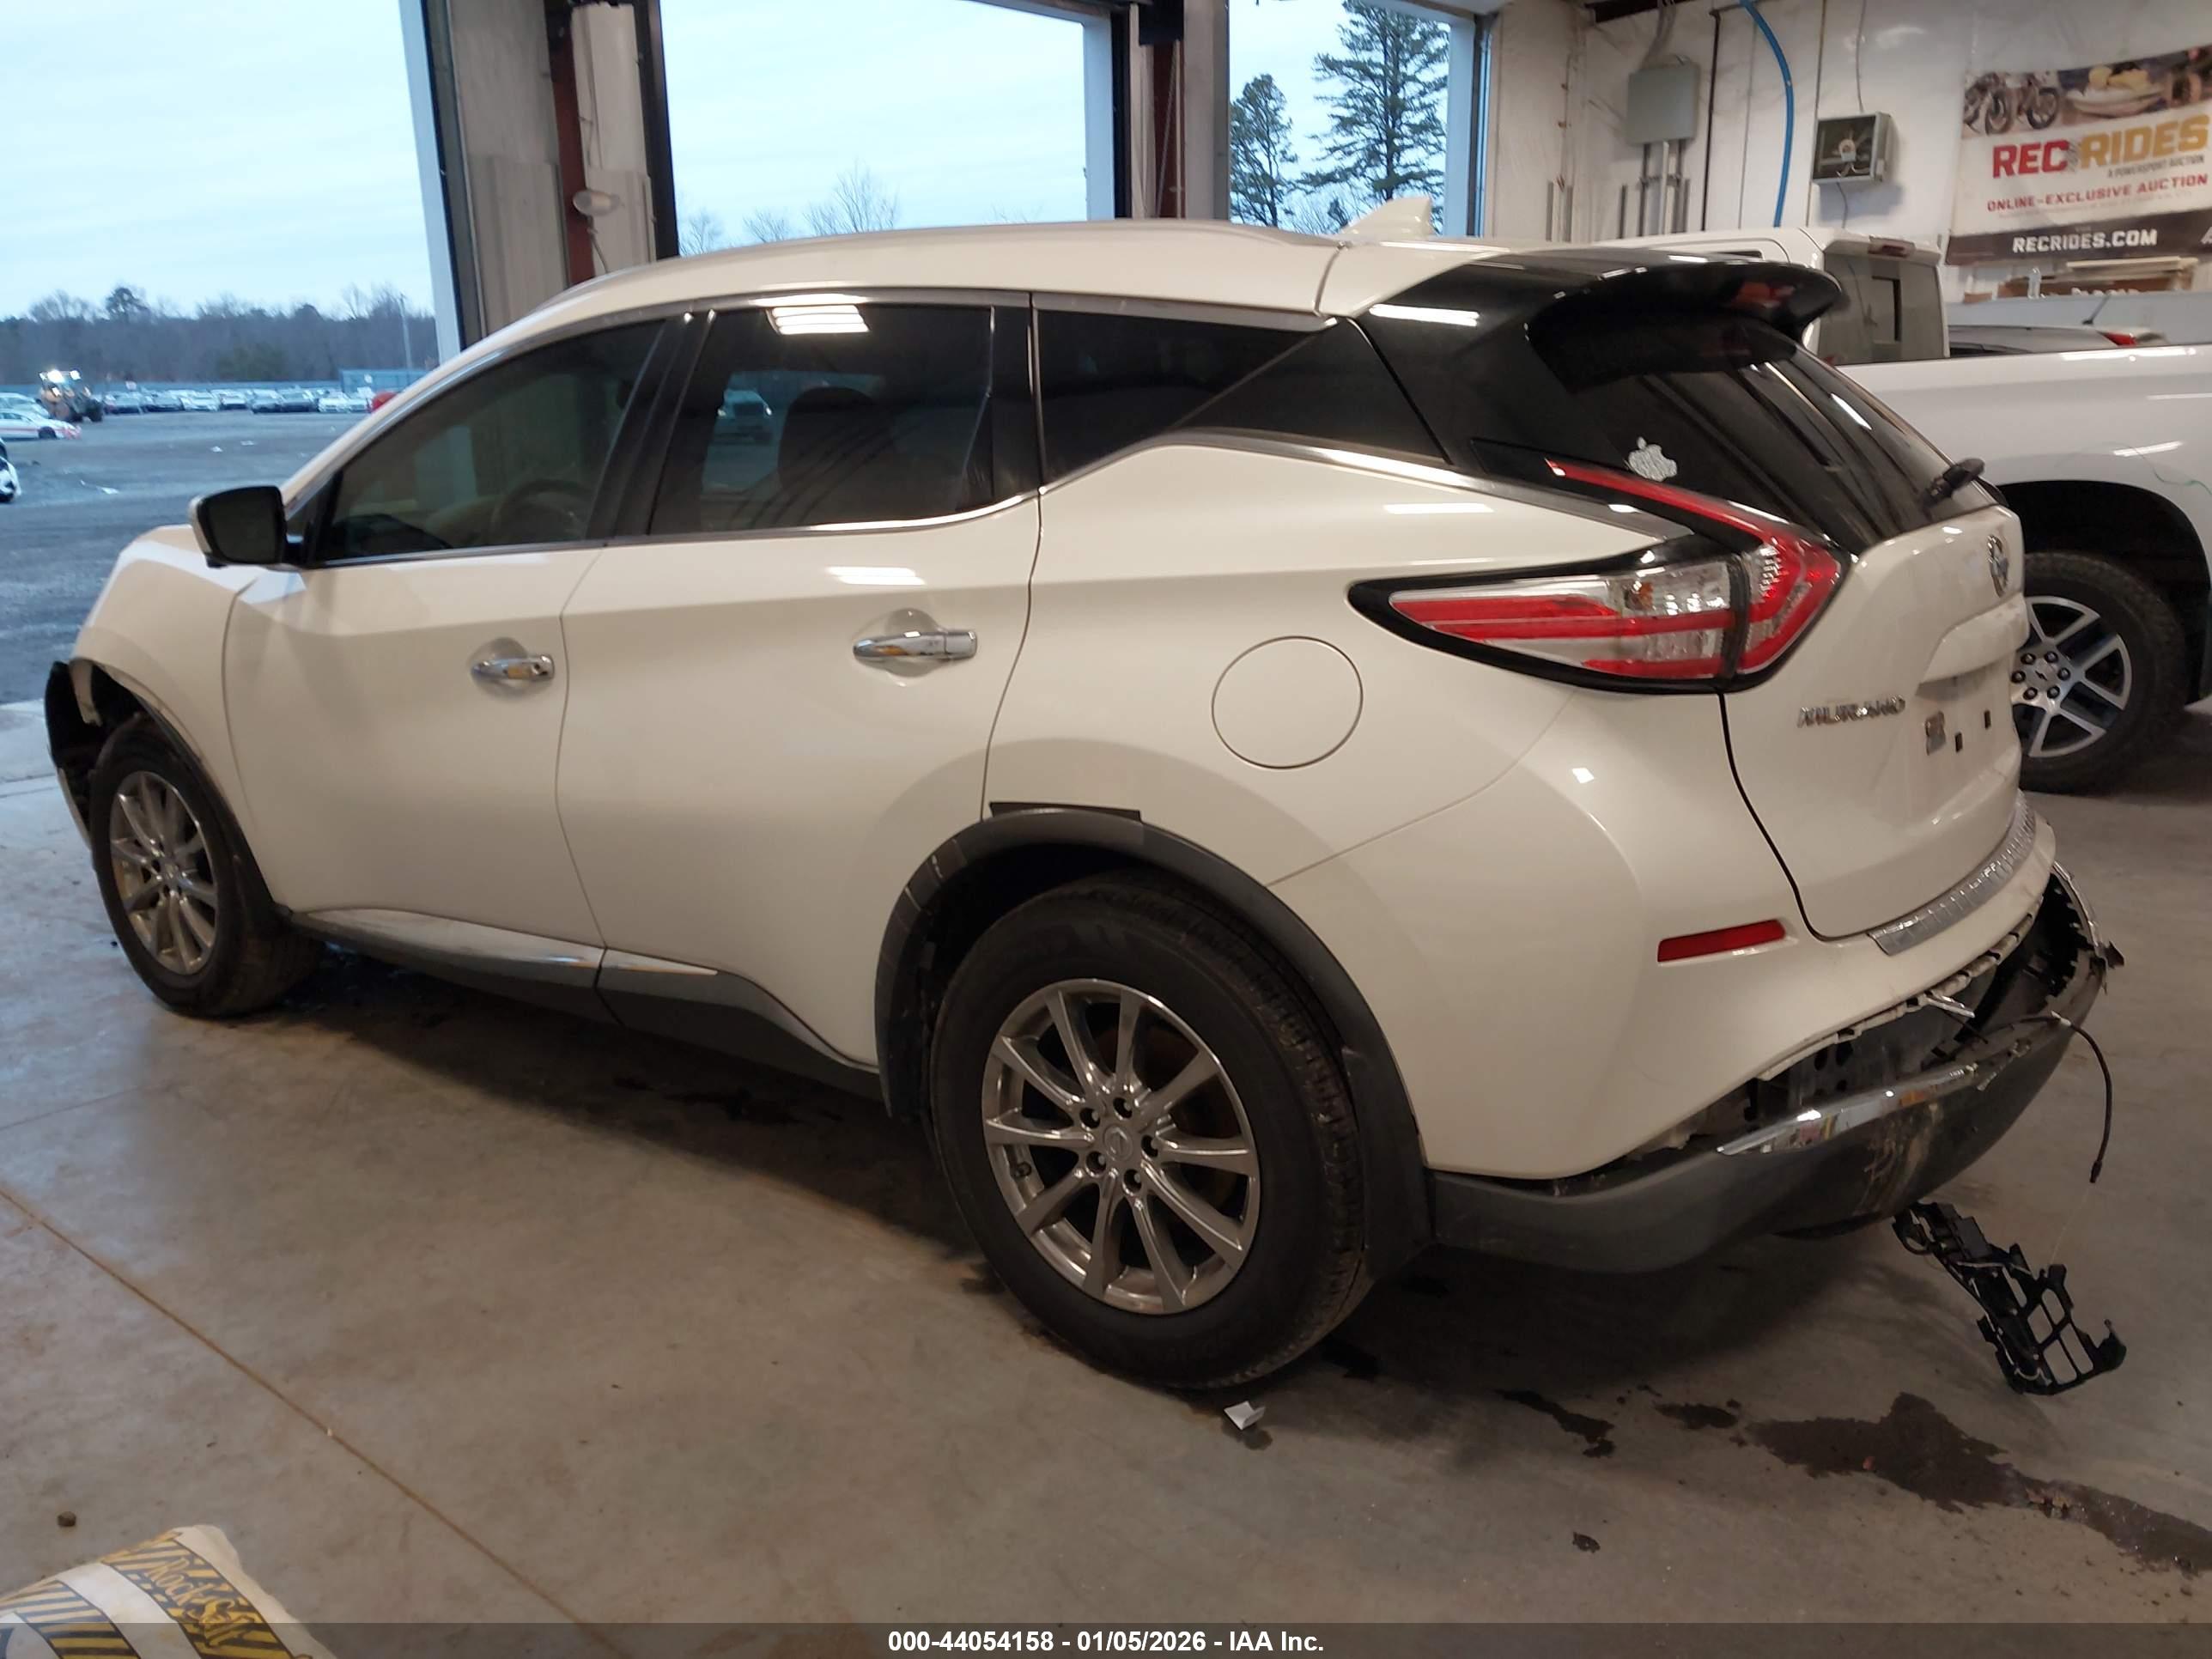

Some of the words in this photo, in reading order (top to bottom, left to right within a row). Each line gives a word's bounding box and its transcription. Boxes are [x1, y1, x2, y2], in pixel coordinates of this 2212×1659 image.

[1992, 139, 2070, 179] REC
[2080, 113, 2210, 170] RIDES
[1987, 184, 2132, 212] ONLINE-EXCLUSIVE
[2136, 173, 2209, 194] AUCTION
[2012, 228, 2158, 253] RECRIDES.COM
[1796, 694, 1906, 729] MURANO
